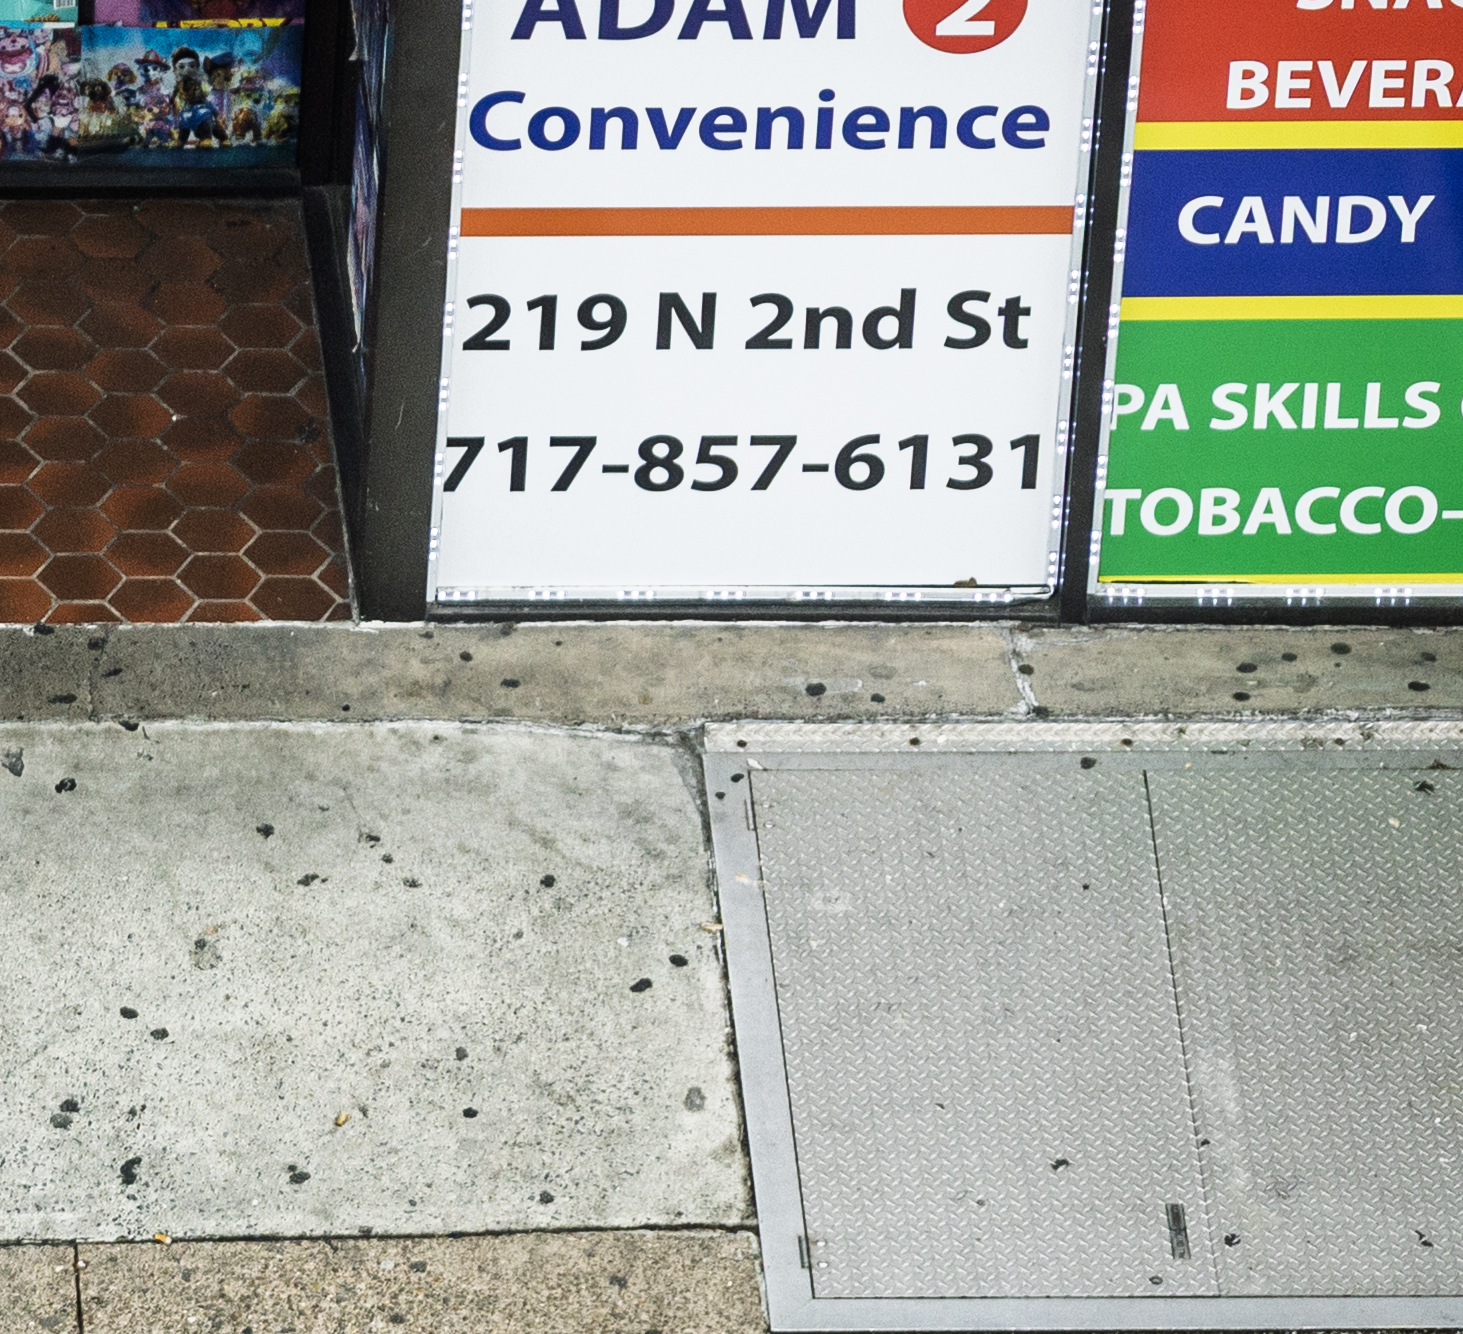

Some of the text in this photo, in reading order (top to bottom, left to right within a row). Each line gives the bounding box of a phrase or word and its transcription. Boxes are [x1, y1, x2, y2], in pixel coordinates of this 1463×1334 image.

[1226, 58, 1463, 110] BEVER
[469, 89, 1050, 151] Convenience
[1178, 195, 1435, 244] CANDY
[463, 288, 1031, 351] 219 N 2nd St
[1107, 382, 1440, 431] PA SKILLS
[443, 434, 1042, 494] 717-857-6131
